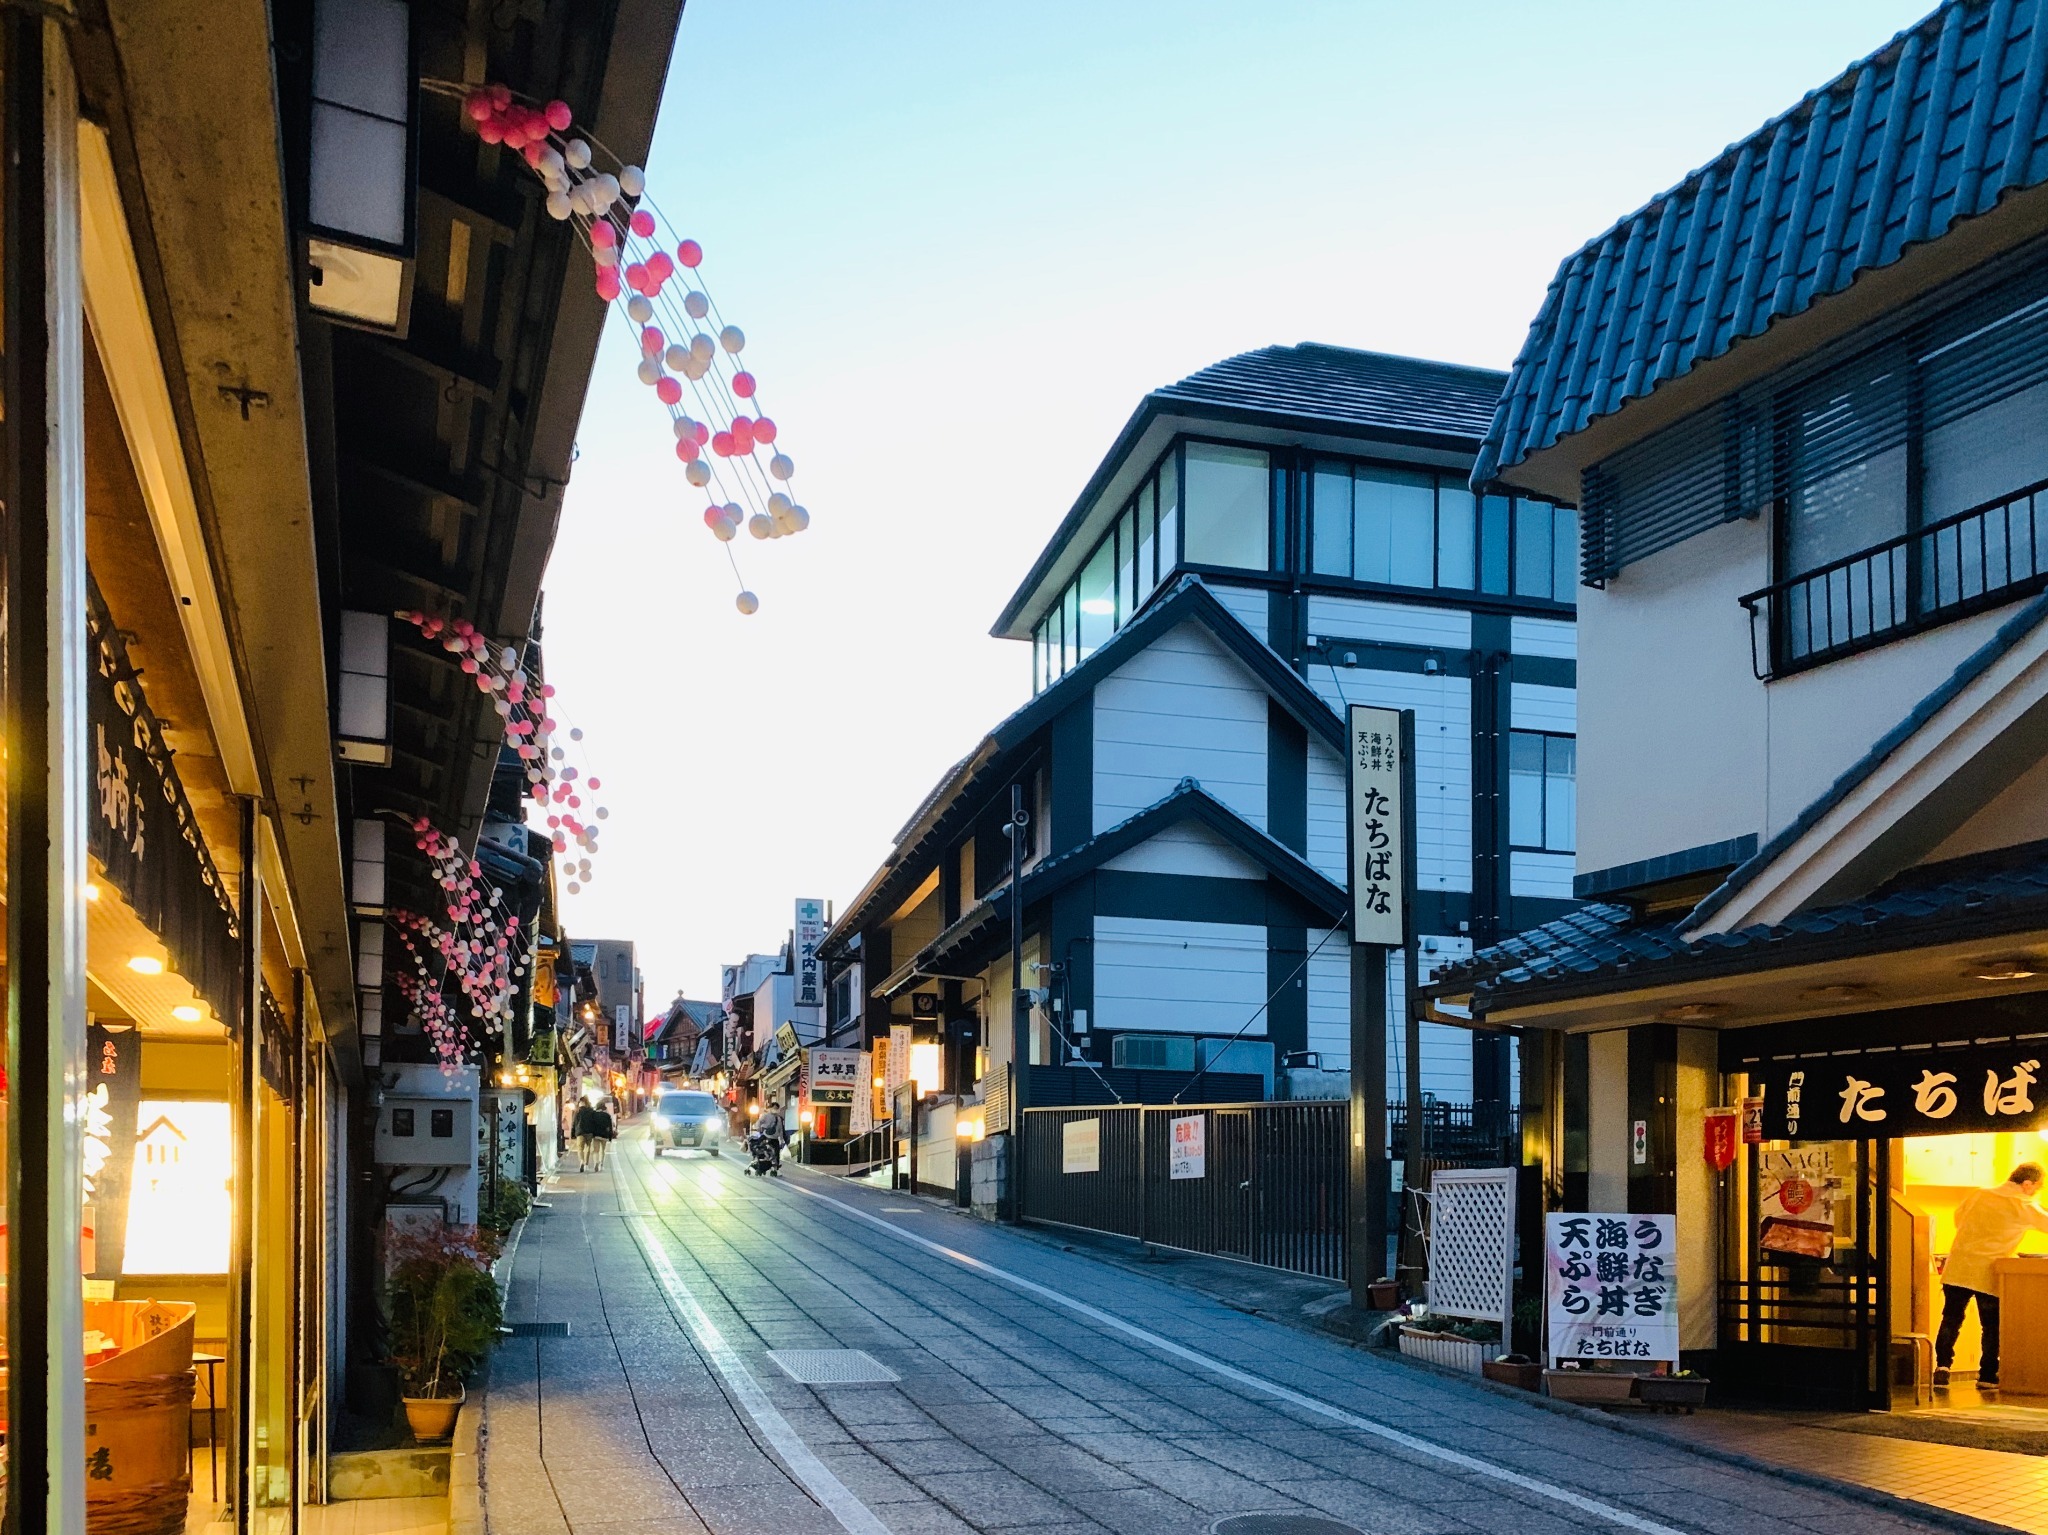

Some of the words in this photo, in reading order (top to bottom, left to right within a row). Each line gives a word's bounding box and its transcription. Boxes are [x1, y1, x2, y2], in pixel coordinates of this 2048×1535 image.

[1384, 733, 1395, 772] うなぎ
[1364, 787, 1392, 914] たちばな
[801, 942, 816, 1002] 木内薬局
[1786, 1071, 1805, 1136] 門前通り
[1838, 1059, 2041, 1124] たちば
[504, 1101, 518, 1165] 御食事処
[1559, 1218, 1592, 1315] 天ぷら
[1595, 1218, 1630, 1317] 海鮮丼
[1634, 1220, 1666, 1317] うなぎ
[1577, 1339, 1651, 1357] たちばな
[1591, 1326, 1637, 1339] 門前通り
